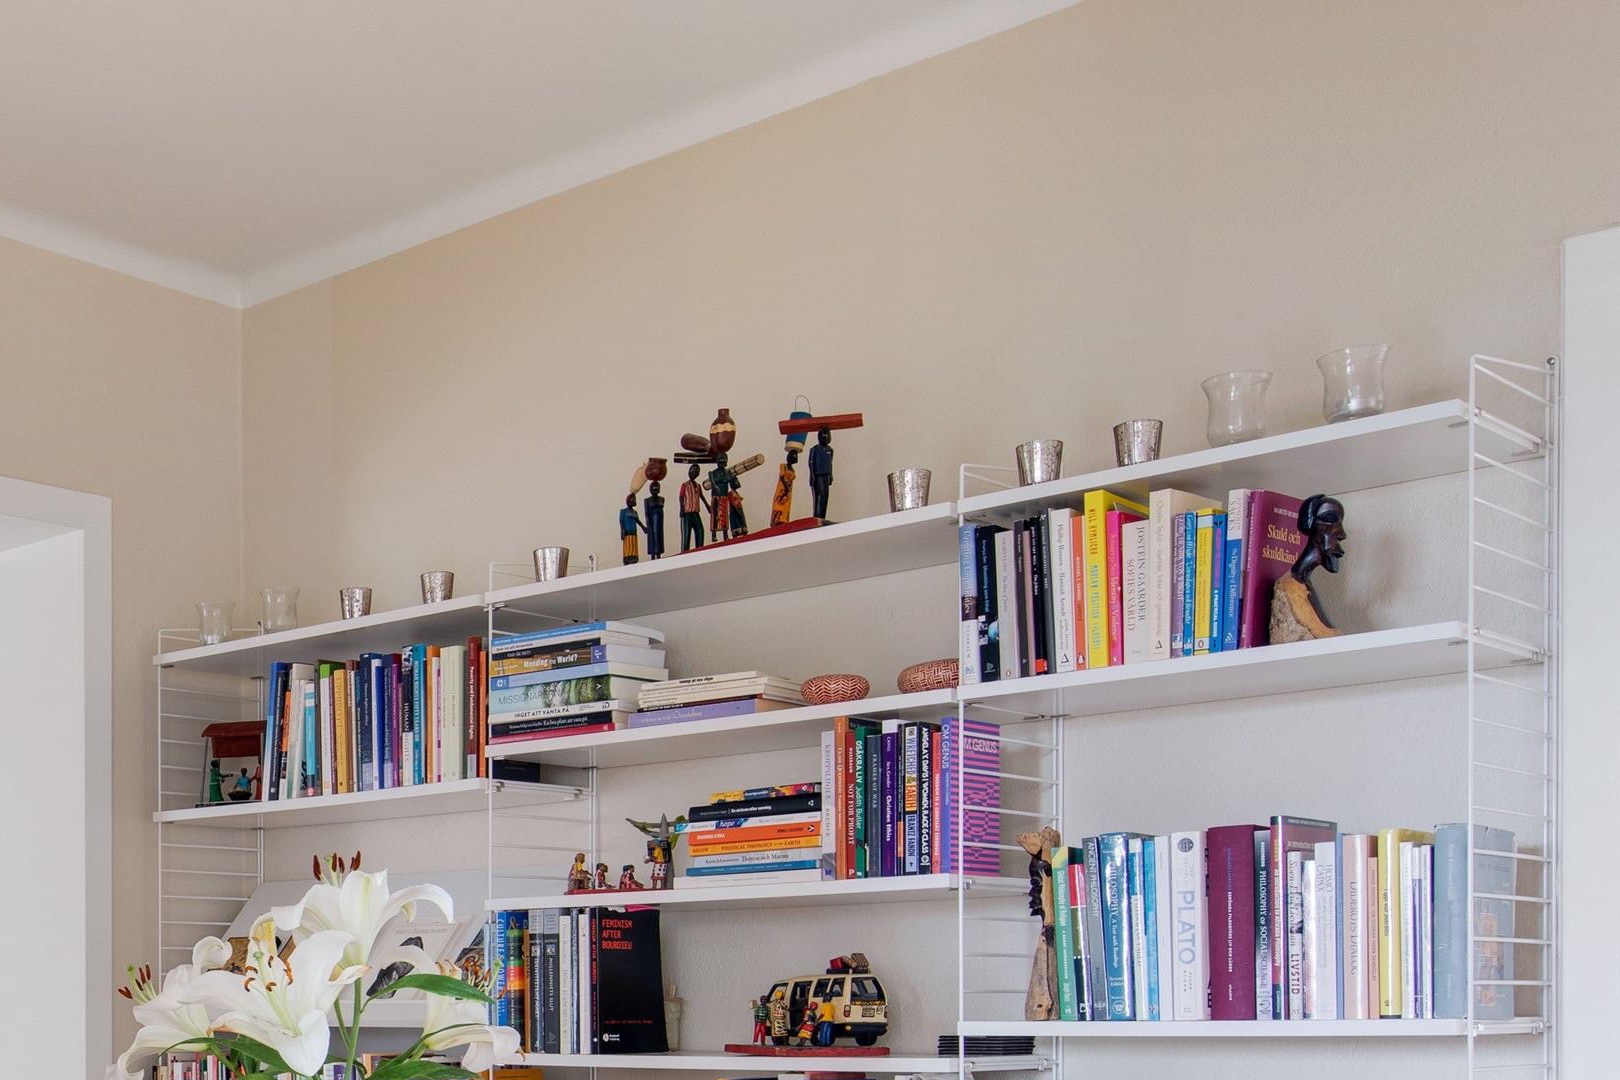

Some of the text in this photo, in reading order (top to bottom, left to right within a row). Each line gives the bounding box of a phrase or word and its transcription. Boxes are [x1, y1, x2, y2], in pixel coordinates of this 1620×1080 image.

[1267, 524, 1301, 545] Skuld och
[1228, 556, 1237, 578] Dignity
[1262, 545, 1298, 564] skuldkänsl
[962, 530, 972, 613] Creating Capabilities
[1137, 527, 1146, 621] JOSTEIN GAARDER
[1109, 577, 1119, 640] Identity Violence
[1127, 559, 1137, 631] SOFIES VÄRLD
[1155, 603, 1163, 636] gemenskap
[524, 654, 578, 668] Mending World?
[942, 724, 949, 739] OM
[906, 737, 915, 775] WRETCHED
[907, 815, 915, 837] FRANTZ
[1087, 842, 1099, 917] ANCIENT PHILOSOPHY
[1109, 862, 1118, 916] PHILOSOPHY
[1316, 864, 1324, 892] CAPAX
[1325, 864, 1333, 893] HOMO
[496, 919, 504, 952] CULTURE
[602, 920, 632, 928] FEMINISM
[602, 930, 621, 938] AFTER
[1177, 890, 1196, 965] PLATO
[1260, 926, 1268, 953] SOCIAL
[1350, 881, 1358, 975] DIDEROTS DIALOG
[602, 941, 632, 950] BOURDIEU
[1291, 954, 1300, 994] LIVSTID
